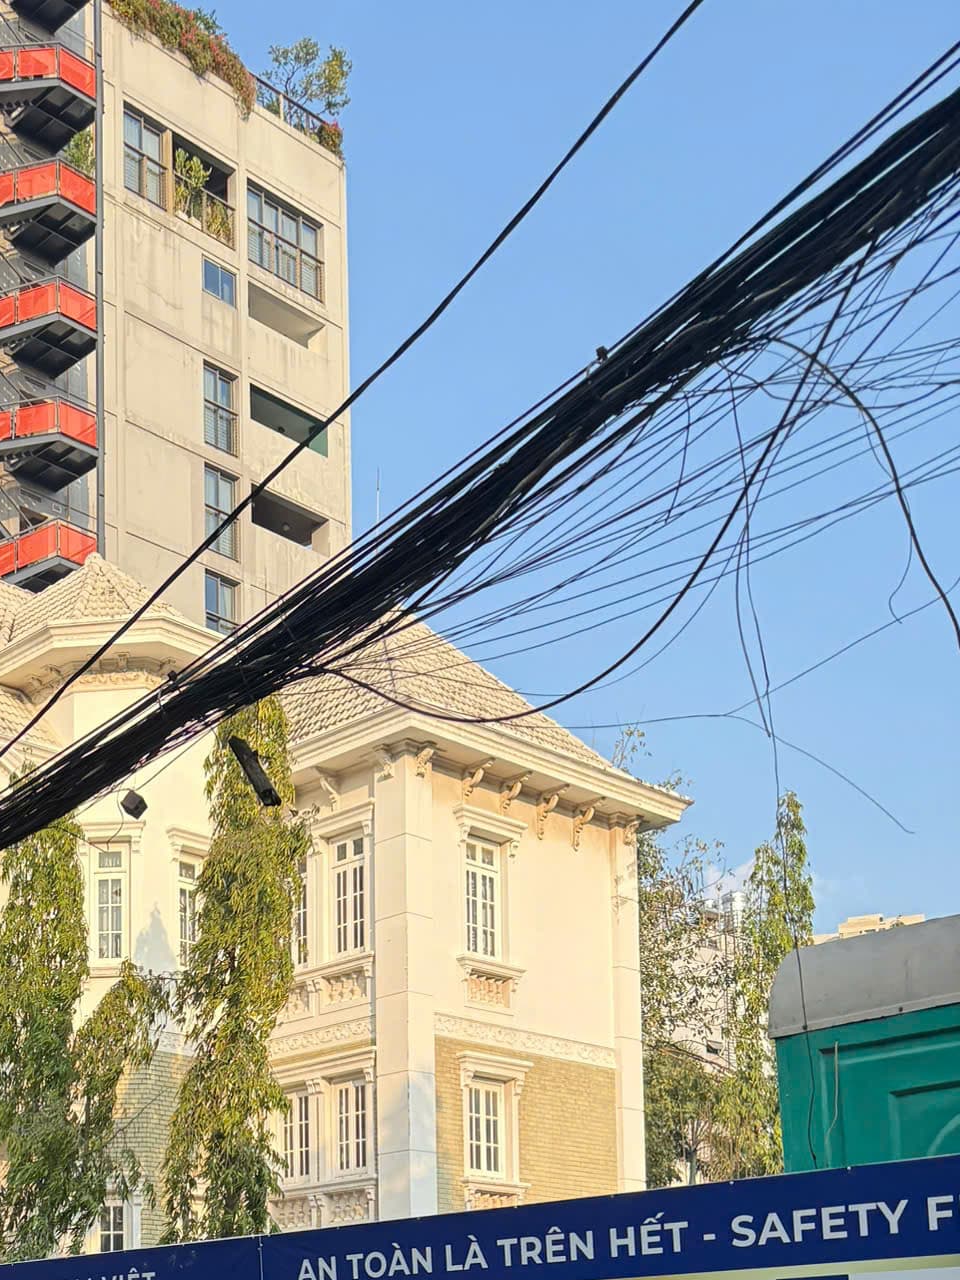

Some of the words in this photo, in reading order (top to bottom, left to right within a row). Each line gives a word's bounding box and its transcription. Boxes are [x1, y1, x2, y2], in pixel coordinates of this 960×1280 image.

[346, 1242, 432, 1279] TOÀN
[445, 1234, 488, 1271] LÀ
[496, 1226, 594, 1266] TRÊN
[609, 1211, 688, 1257] HẾT
[731, 1199, 908, 1247] SAFETY
[927, 1185, 960, 1245] F
